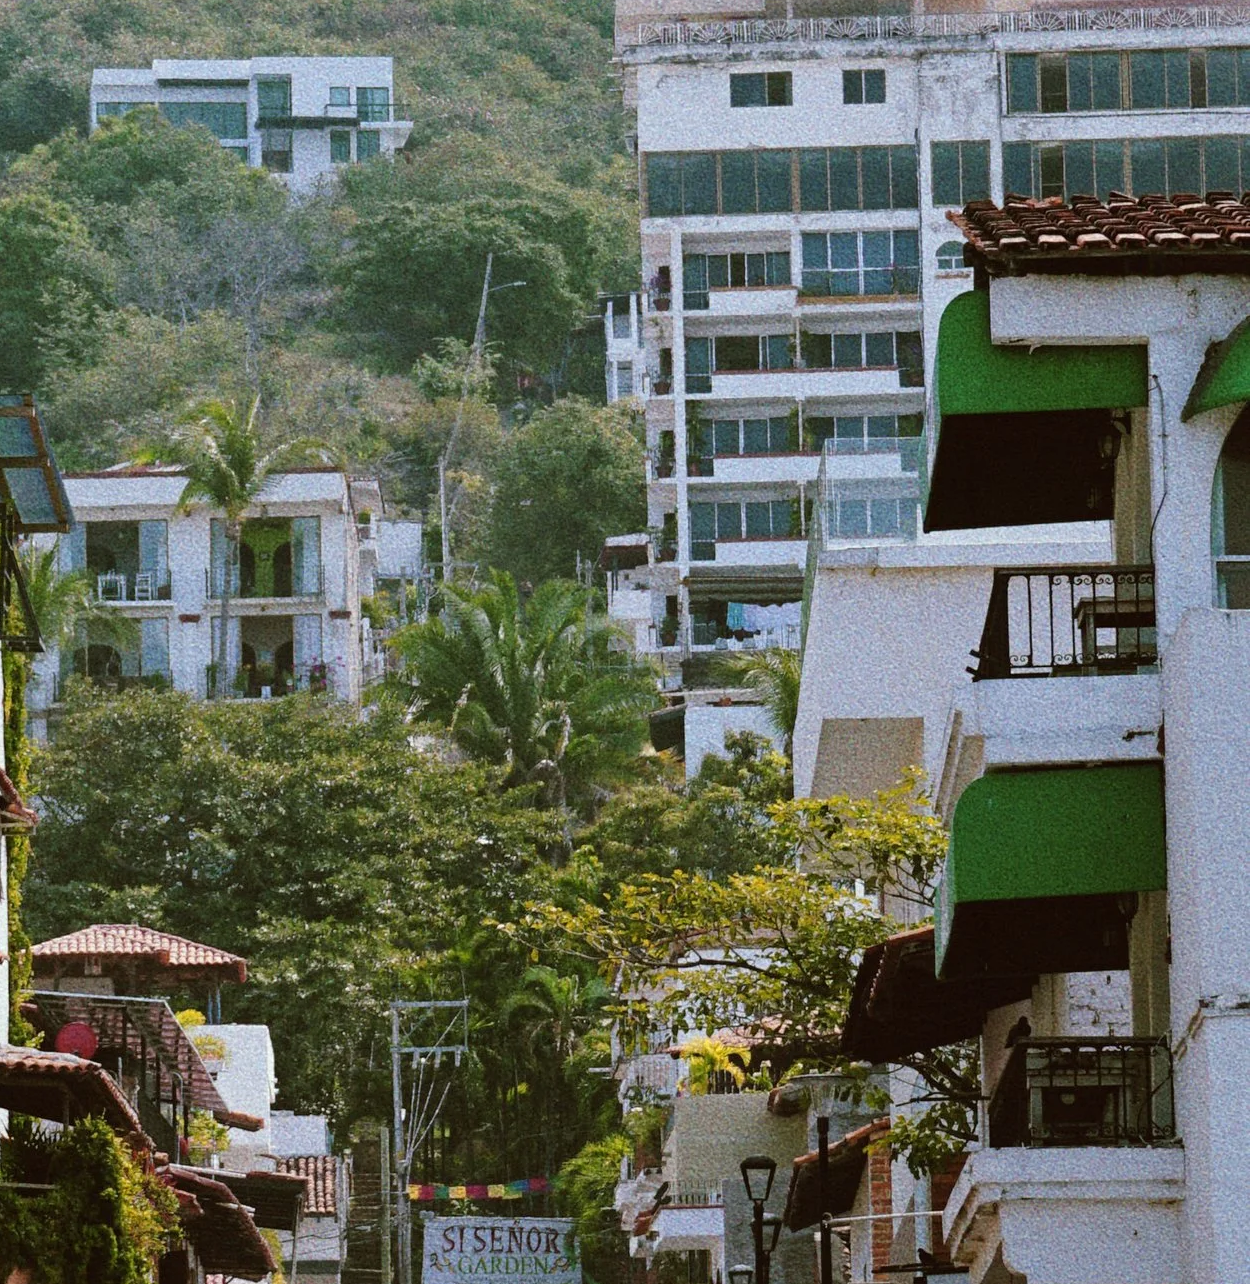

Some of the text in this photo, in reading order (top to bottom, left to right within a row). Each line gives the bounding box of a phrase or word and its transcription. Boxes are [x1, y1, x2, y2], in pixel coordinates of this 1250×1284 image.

[442, 1219, 561, 1254] SI SEÑOR
[457, 1256, 551, 1275] GARDEN
